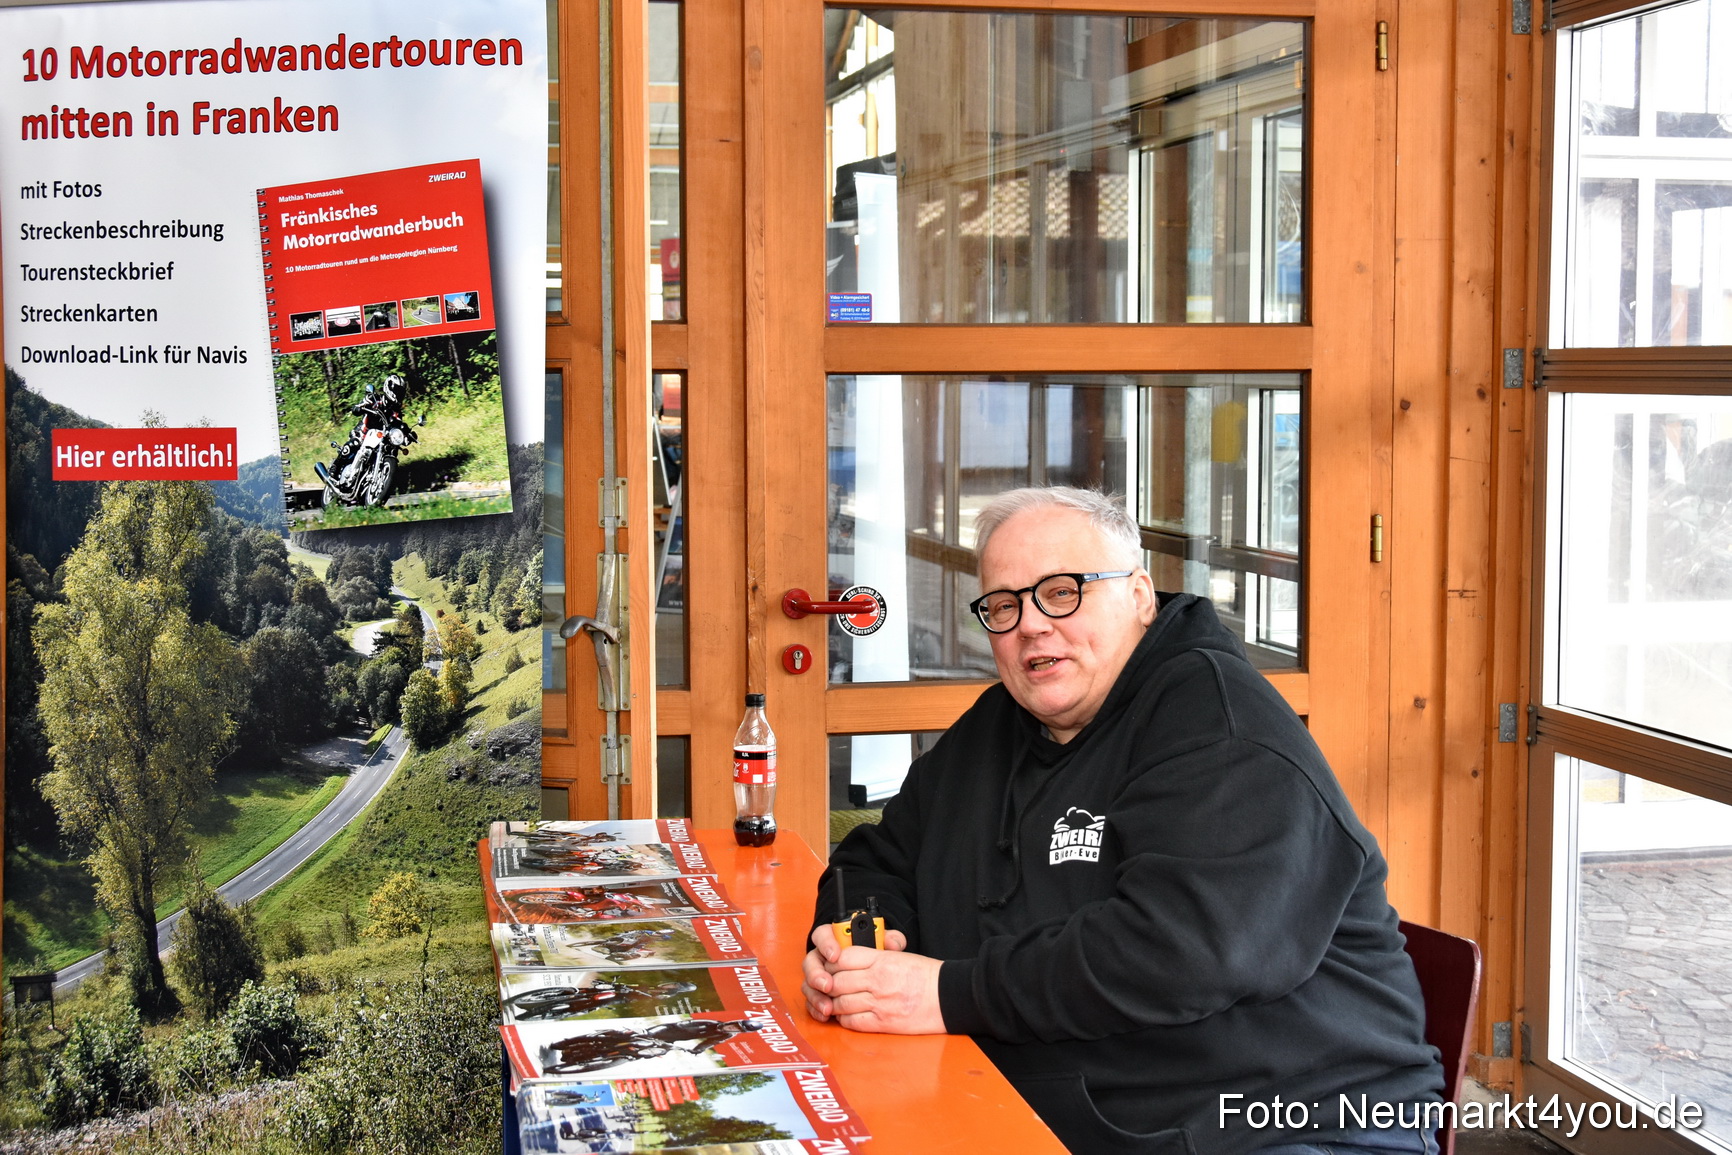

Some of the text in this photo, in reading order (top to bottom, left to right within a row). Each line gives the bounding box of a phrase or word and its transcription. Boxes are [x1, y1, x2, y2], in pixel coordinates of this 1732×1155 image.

[22, 33, 523, 82] 10 Motorradwandertouren
[21, 97, 339, 141] mitten in Franken
[20, 181, 102, 199] mit Fotos
[428, 171, 467, 183] ZWEIRAD
[278, 188, 344, 203] Mathias Thomaschek
[281, 202, 378, 228] Fränkisches
[20, 219, 224, 242] Streckenbeschreibung
[283, 211, 464, 251] Motorradwanderbuch
[20, 261, 175, 282] Tourensteckbrief
[285, 266, 294, 274] 10
[295, 260, 343, 272] Motorradtouren
[344, 258, 358, 266] rund
[369, 254, 379, 262] die
[380, 248, 427, 262] Metropolregion
[427, 245, 458, 255] Nürnberg
[20, 303, 158, 323] Streckenkarten
[21, 345, 248, 364] Download-Link für Navis
[56, 443, 233, 468] Hier erhältlich!
[666, 818, 690, 843] ZWEIRAD
[679, 843, 707, 869] ZWEIRAD
[686, 876, 729, 909] ZWEIRAD
[703, 918, 742, 953] ZWEIRAD
[733, 966, 773, 1004] ZWEIRAD
[744, 1009, 799, 1054] ZWEIRAD
[794, 1069, 849, 1123] ZWEIRAD
